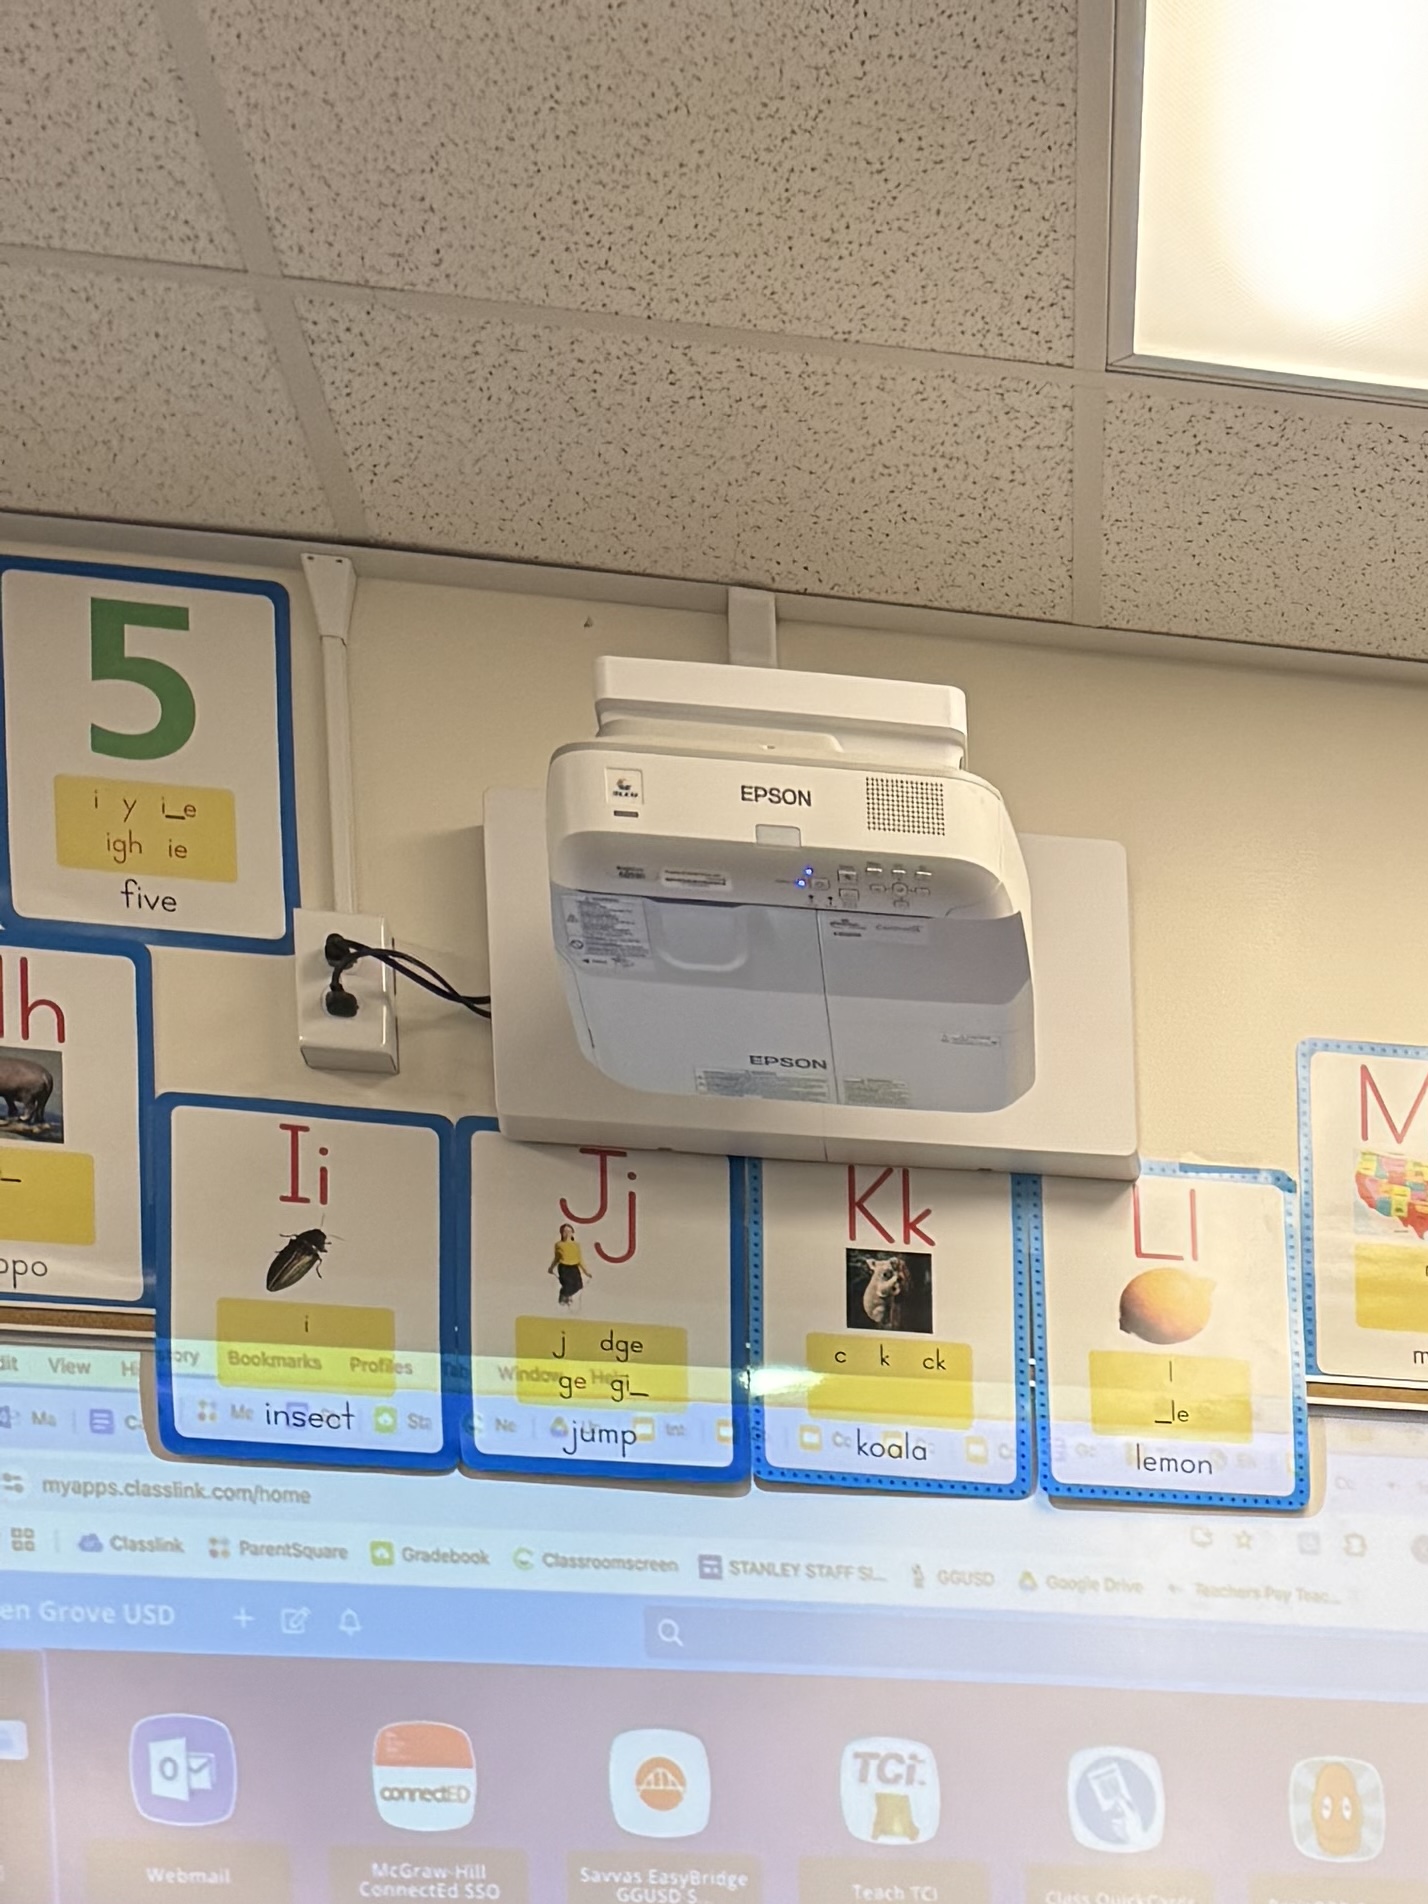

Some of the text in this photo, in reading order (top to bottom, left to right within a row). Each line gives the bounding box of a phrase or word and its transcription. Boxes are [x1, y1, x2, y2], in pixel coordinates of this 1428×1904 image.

[90, 597, 195, 760] 5
[741, 785, 811, 806] EPSON
[121, 883, 177, 914] five
[749, 1055, 827, 1069] EPSON
[280, 1123, 329, 1205] Ii
[228, 1350, 322, 1370] Bookmarks
[265, 1401, 355, 1430] insect
[563, 1420, 636, 1456] jump
[857, 1430, 927, 1461] koala
[1136, 1444, 1212, 1475] lemon
[42, 1479, 311, 1504] myapps.classlink.com/home
[110, 1536, 347, 1560] Classlink ParentSquare
[39, 1602, 175, 1625] Grove USD
[146, 1867, 230, 1884] Webmail
